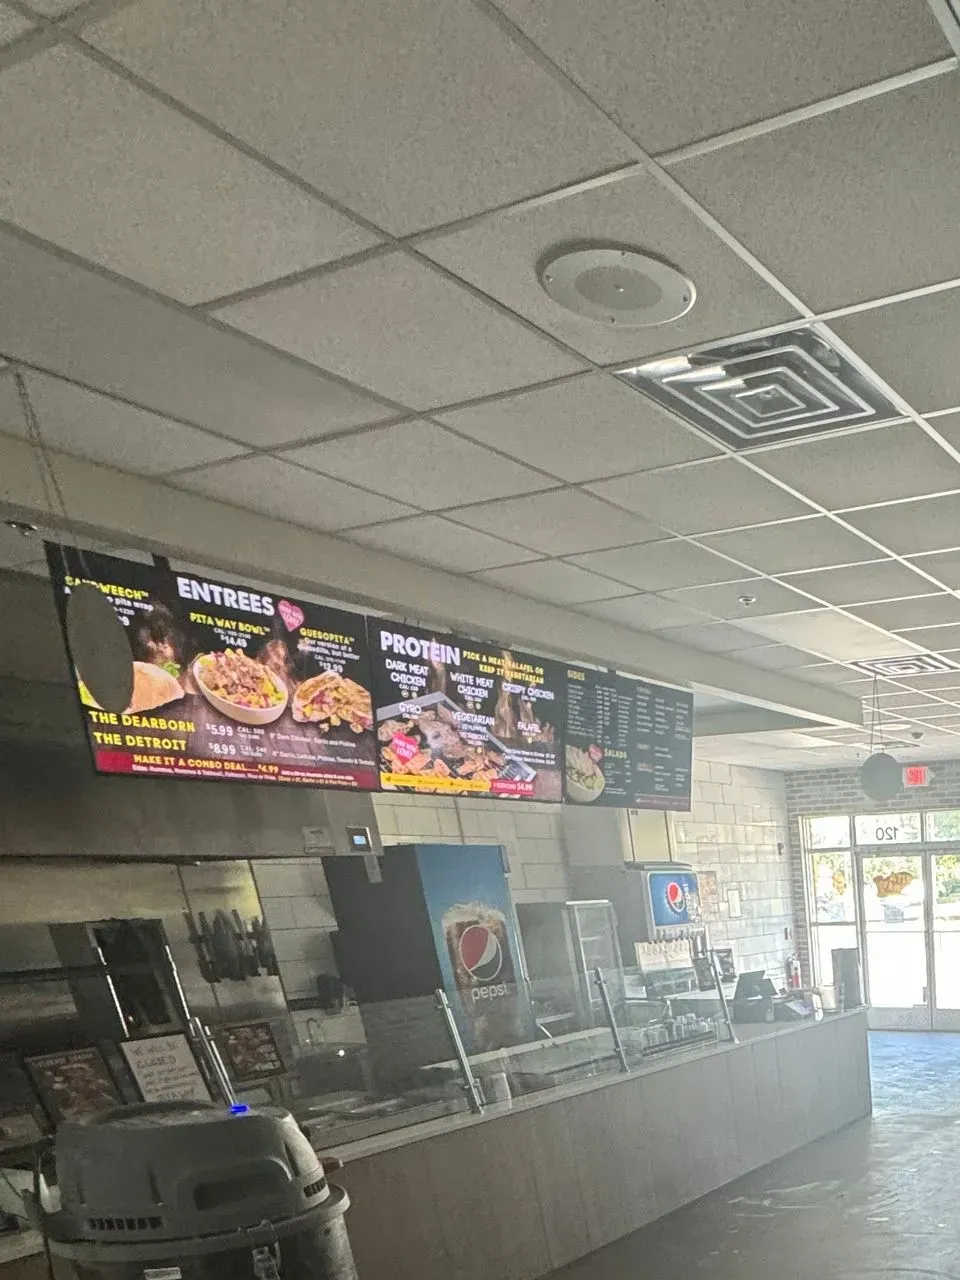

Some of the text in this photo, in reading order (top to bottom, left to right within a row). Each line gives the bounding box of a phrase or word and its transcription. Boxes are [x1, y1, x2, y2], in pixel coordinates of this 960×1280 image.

[176, 576, 275, 616] ENTREES
[189, 611, 215, 626] PITA
[215, 617, 238, 630] WAY
[299, 627, 350, 645] QUESOPITA
[380, 630, 461, 666] PROTEIN
[463, 650, 481, 662] PICK
[482, 654, 487, 663] A
[385, 658, 429, 677] DARK MEAT
[479, 664, 495, 674] KEEP
[390, 672, 427, 687] CHICKEN
[449, 671, 494, 689] WHITE MEAT
[457, 685, 489, 698] CHICKEN
[502, 682, 526, 695] CRISPY
[527, 687, 555, 700] CHICKEN
[398, 702, 422, 715] GYRO
[89, 710, 196, 733] THE DEARBORN
[451, 710, 496, 727] VEGETARIAN
[206, 722, 234, 737] $5.99
[93, 731, 187, 751] THE DETROIT
[208, 742, 236, 755] $8.99
[133, 754, 162, 764] MAKE
[163, 757, 175, 766] IT
[178, 758, 186, 767] A
[187, 759, 223, 769] COMBO
[471, 980, 507, 1004] pepsi
